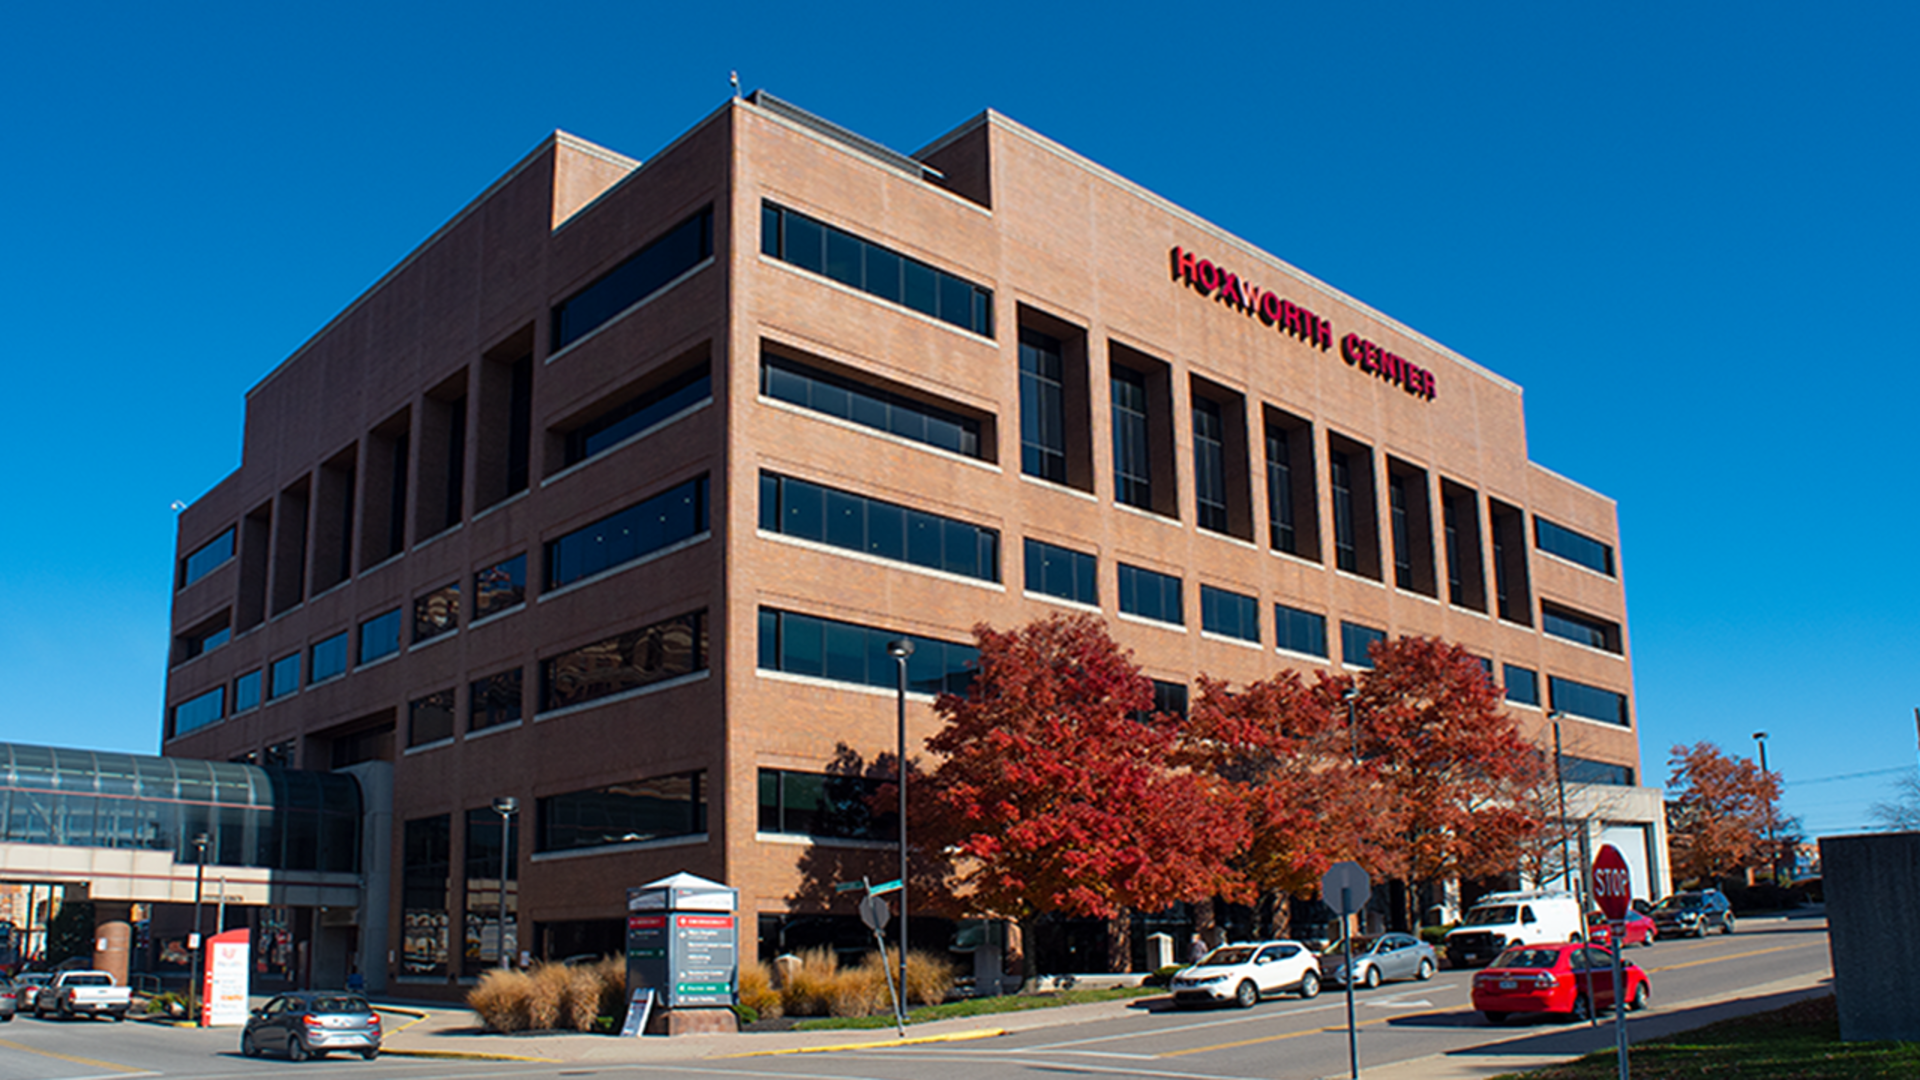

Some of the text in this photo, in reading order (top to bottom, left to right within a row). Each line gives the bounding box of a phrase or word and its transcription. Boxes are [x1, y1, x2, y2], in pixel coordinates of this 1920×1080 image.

[1171, 246, 1437, 402] HOXWORTH CENTER
[1595, 868, 1628, 896] STOP
